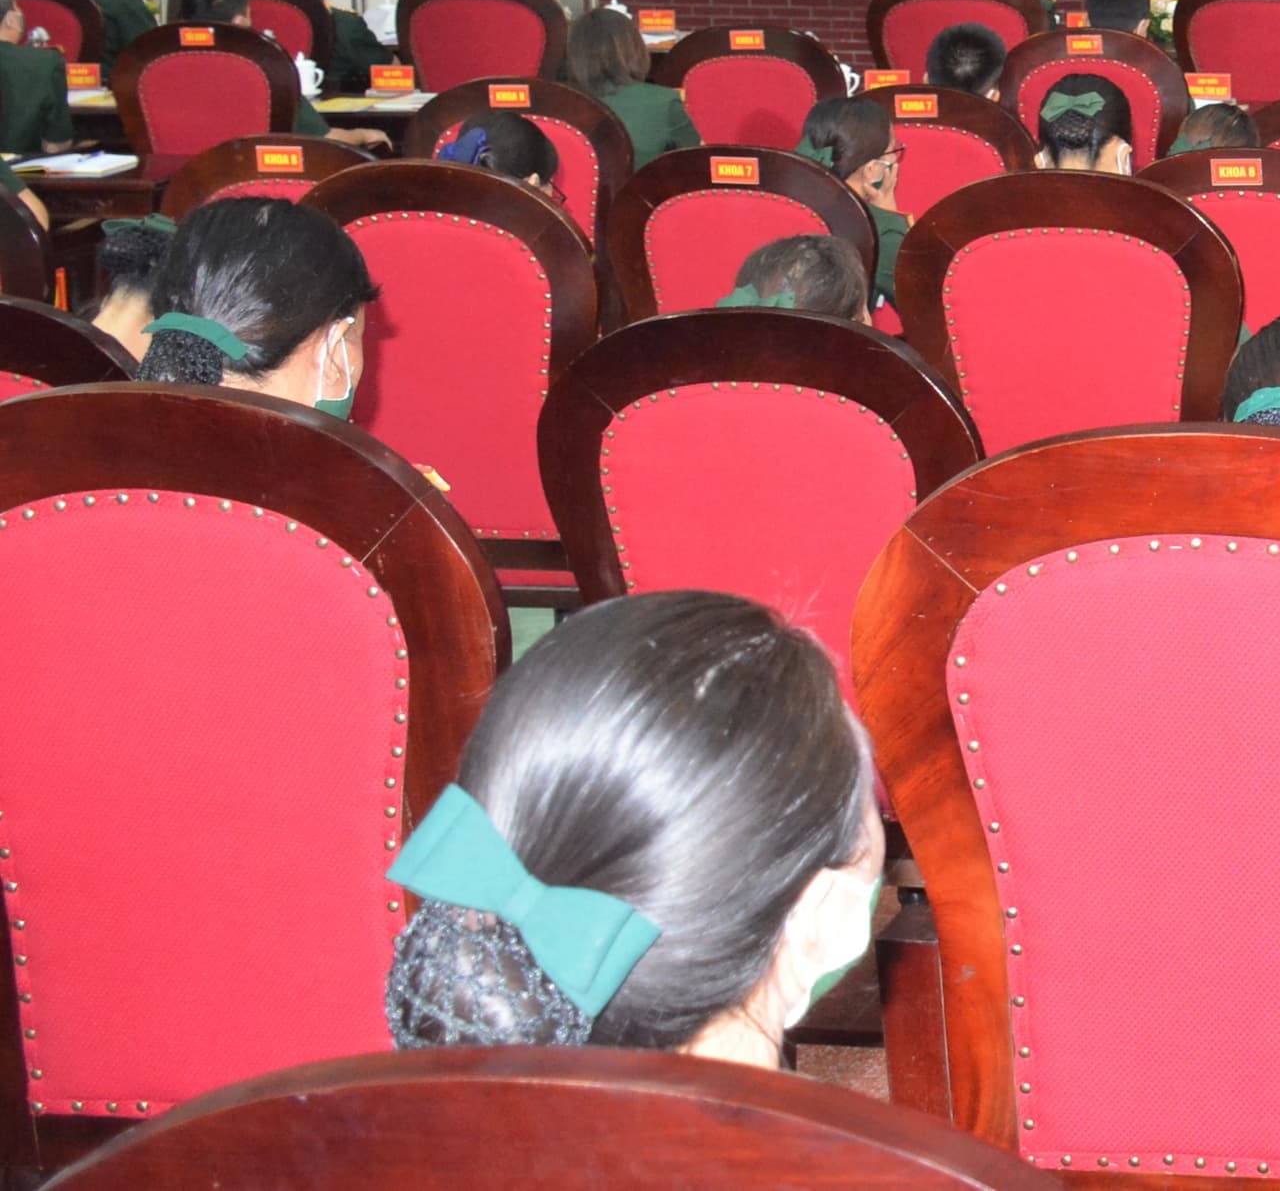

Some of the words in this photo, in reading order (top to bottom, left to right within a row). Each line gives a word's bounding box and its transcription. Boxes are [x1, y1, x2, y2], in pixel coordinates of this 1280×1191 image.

[902, 101, 924, 111] KHOA
[719, 165, 744, 176] KHOA
[1219, 167, 1246, 178] KHOA
